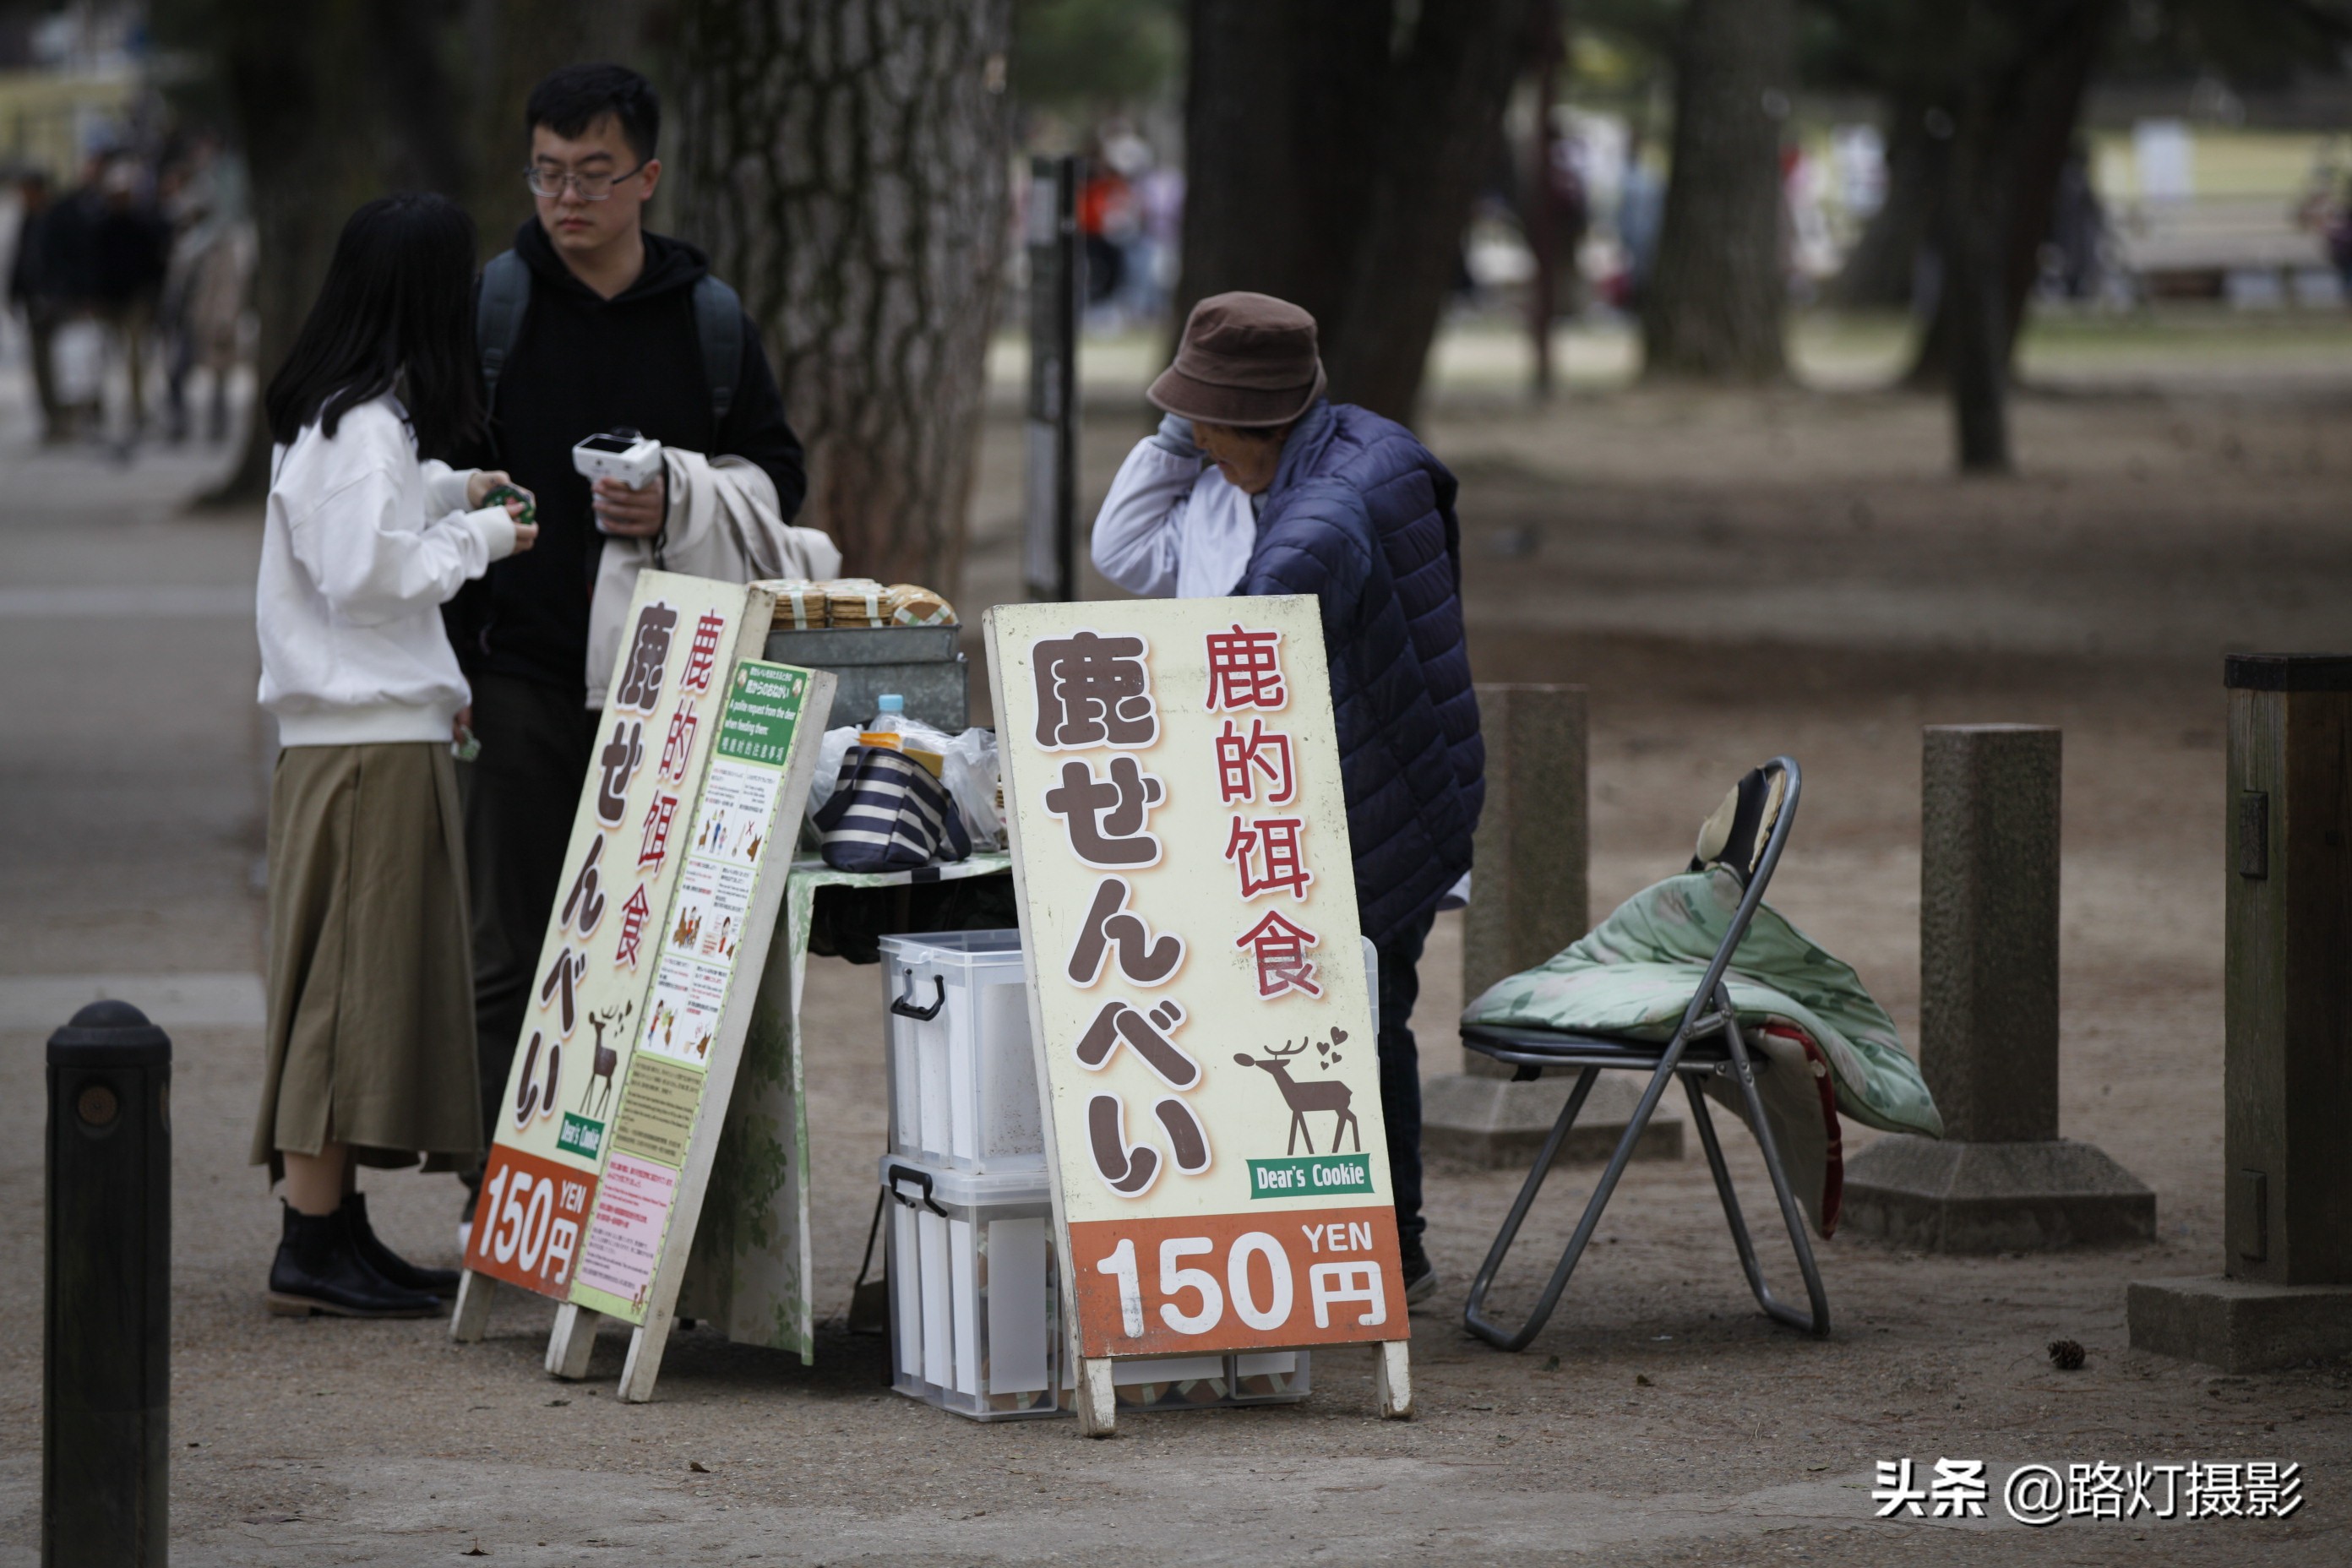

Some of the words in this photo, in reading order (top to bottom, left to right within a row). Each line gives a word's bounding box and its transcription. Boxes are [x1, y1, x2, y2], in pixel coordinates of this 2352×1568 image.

[725, 717, 738, 730] when
[738, 718, 755, 736] feeding
[733, 700, 748, 712] polite
[748, 704, 765, 716] request
[765, 704, 776, 717] from
[776, 706, 785, 719] the
[784, 708, 797, 721] deer
[616, 608, 725, 967] 鹿的饵食
[1205, 623, 1320, 997] 鹿的饵食
[515, 601, 678, 1125] 鹿せんべい
[1032, 630, 1207, 1193] 鹿せんべい
[479, 1164, 553, 1272] 150
[560, 1179, 587, 1214] YEN
[1256, 1165, 1305, 1190] Dear's
[1312, 1163, 1365, 1187] Cookie
[1097, 1231, 1293, 1338] 150
[1302, 1222, 1373, 1253] YEN
